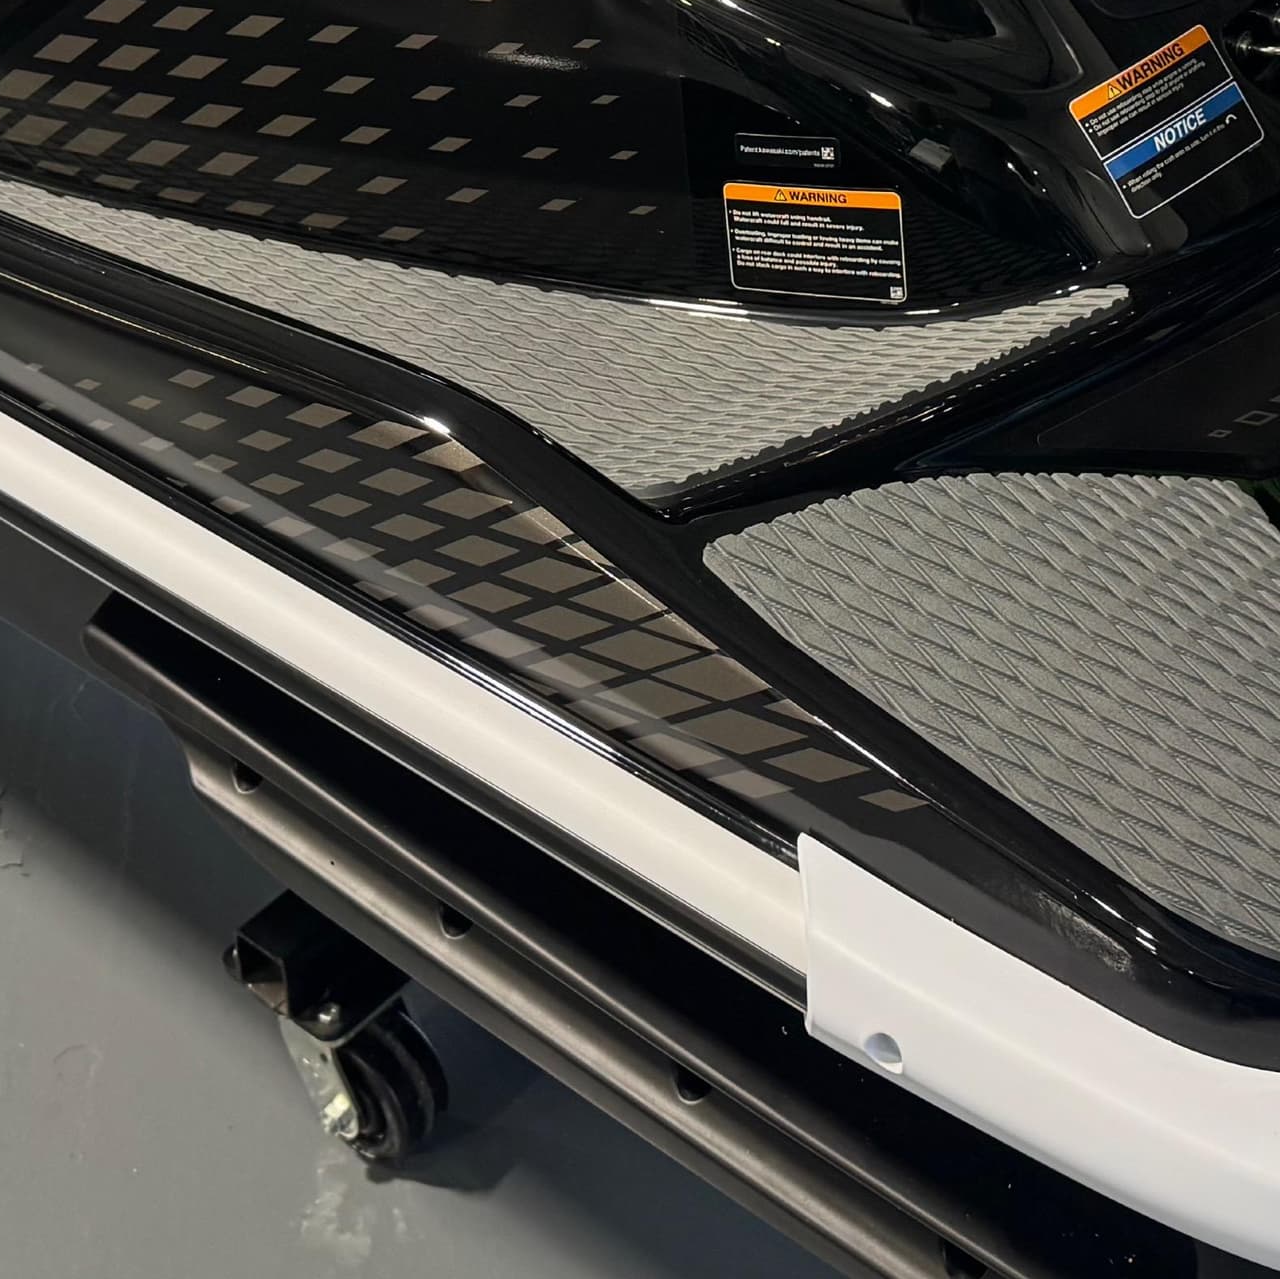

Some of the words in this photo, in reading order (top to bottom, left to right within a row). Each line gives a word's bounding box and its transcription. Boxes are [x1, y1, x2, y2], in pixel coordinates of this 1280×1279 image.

[1117, 43, 1183, 88] WARNING
[1153, 108, 1205, 151] NOTICE
[789, 191, 846, 202] WARNING
